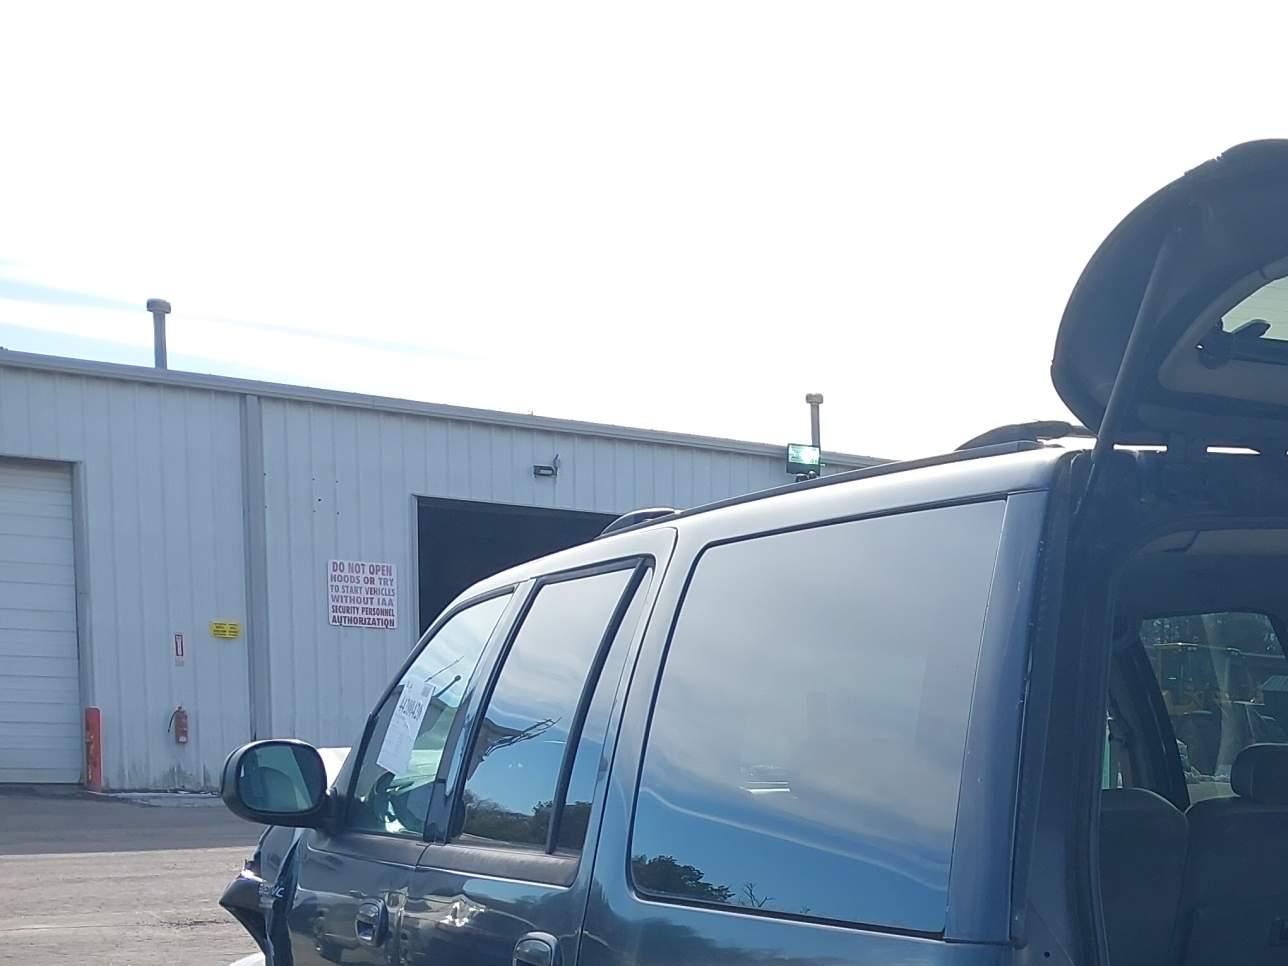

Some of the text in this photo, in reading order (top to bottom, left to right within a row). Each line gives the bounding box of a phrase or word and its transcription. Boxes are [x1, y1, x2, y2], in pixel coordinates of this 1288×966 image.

[332, 561, 393, 577] DO NOT OPEN
[330, 574, 394, 587] HOODS OR TRY
[330, 584, 395, 597] TO START VEHICLES
[331, 594, 394, 607] WITHOUT IAA
[331, 604, 395, 617] SECURITY PERSONNEL
[331, 615, 395, 627] AUTHORIZATION
